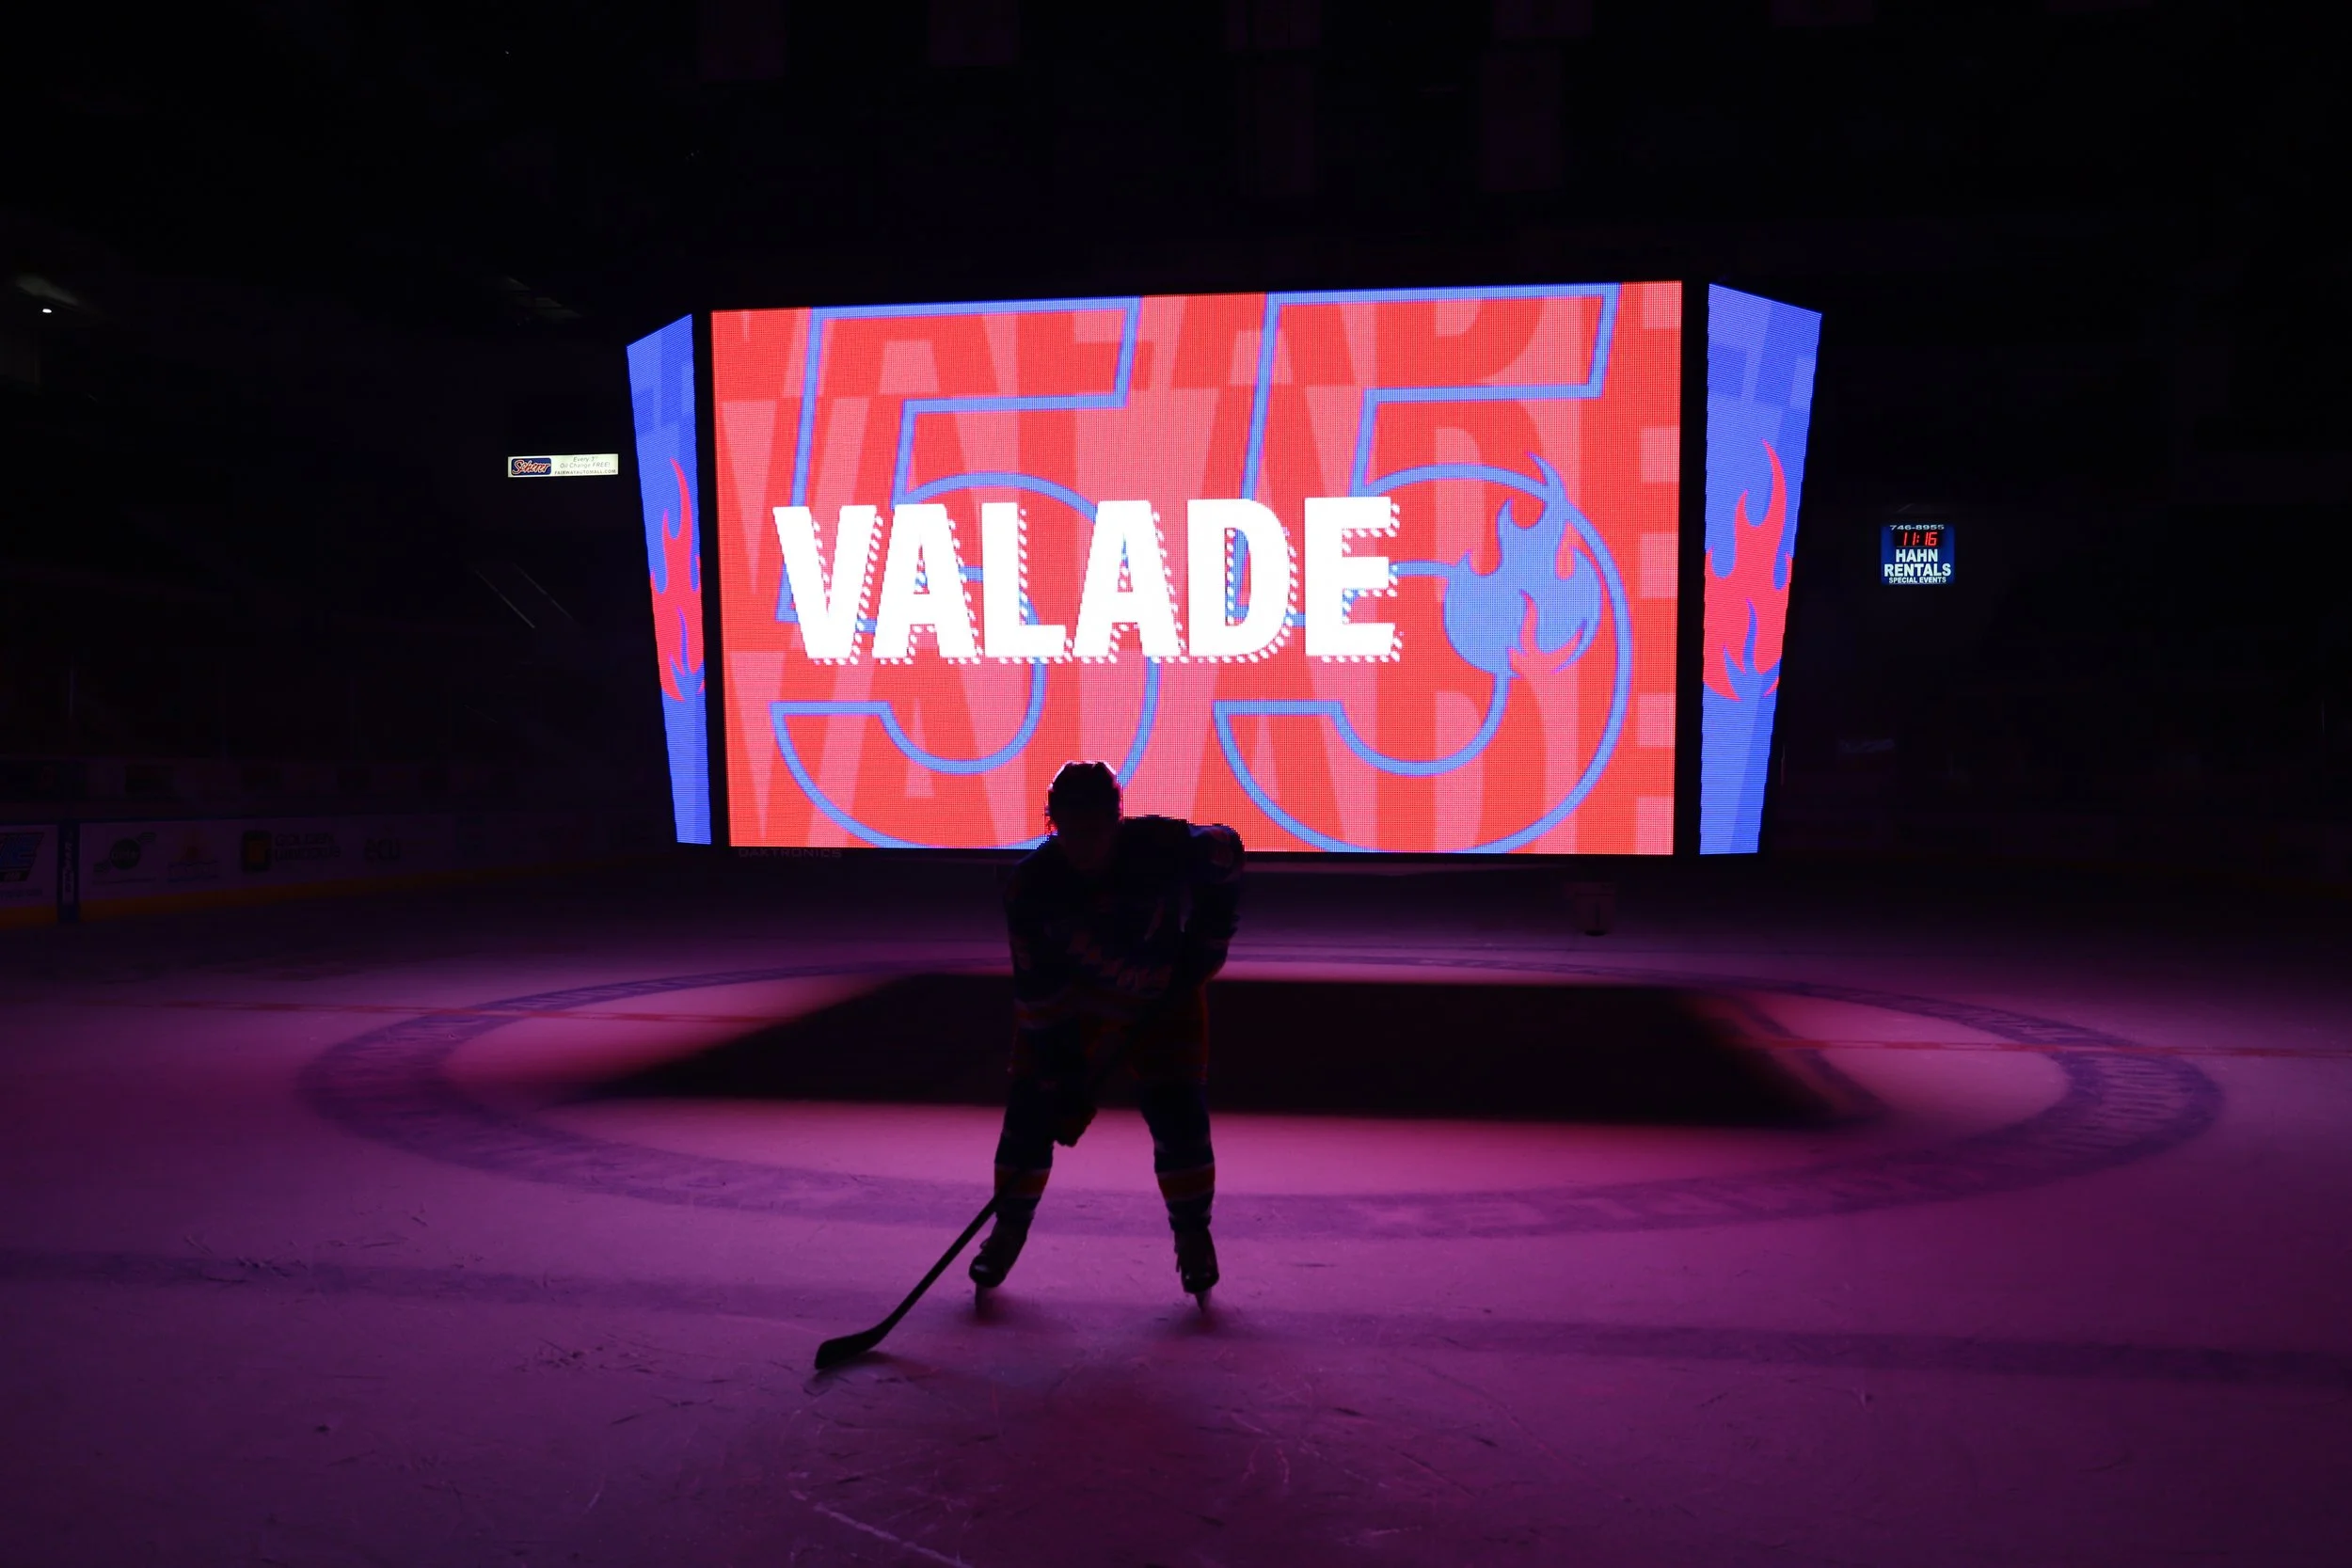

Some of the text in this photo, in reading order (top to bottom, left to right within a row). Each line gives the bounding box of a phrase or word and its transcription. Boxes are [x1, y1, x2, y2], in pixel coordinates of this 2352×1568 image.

[1903, 531, 1938, 546] 11:16
[1895, 548, 1938, 562] HAHN
[1883, 562, 1952, 577] RENTALS
[772, 497, 1401, 664] VALADE
